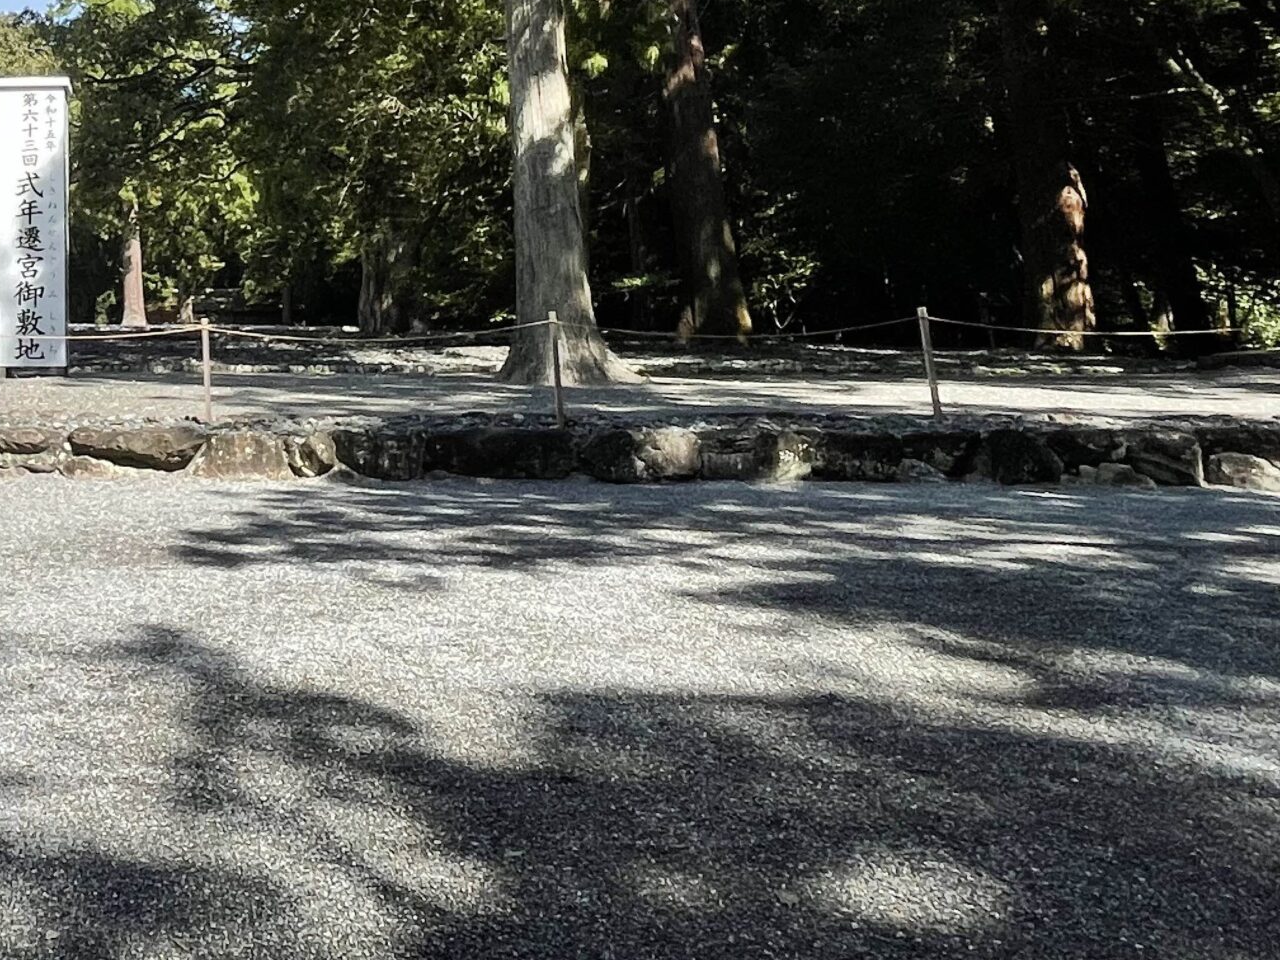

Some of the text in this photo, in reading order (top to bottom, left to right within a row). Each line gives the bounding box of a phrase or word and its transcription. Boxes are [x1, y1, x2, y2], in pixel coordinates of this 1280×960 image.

[45, 93, 58, 152] 令和十五年
